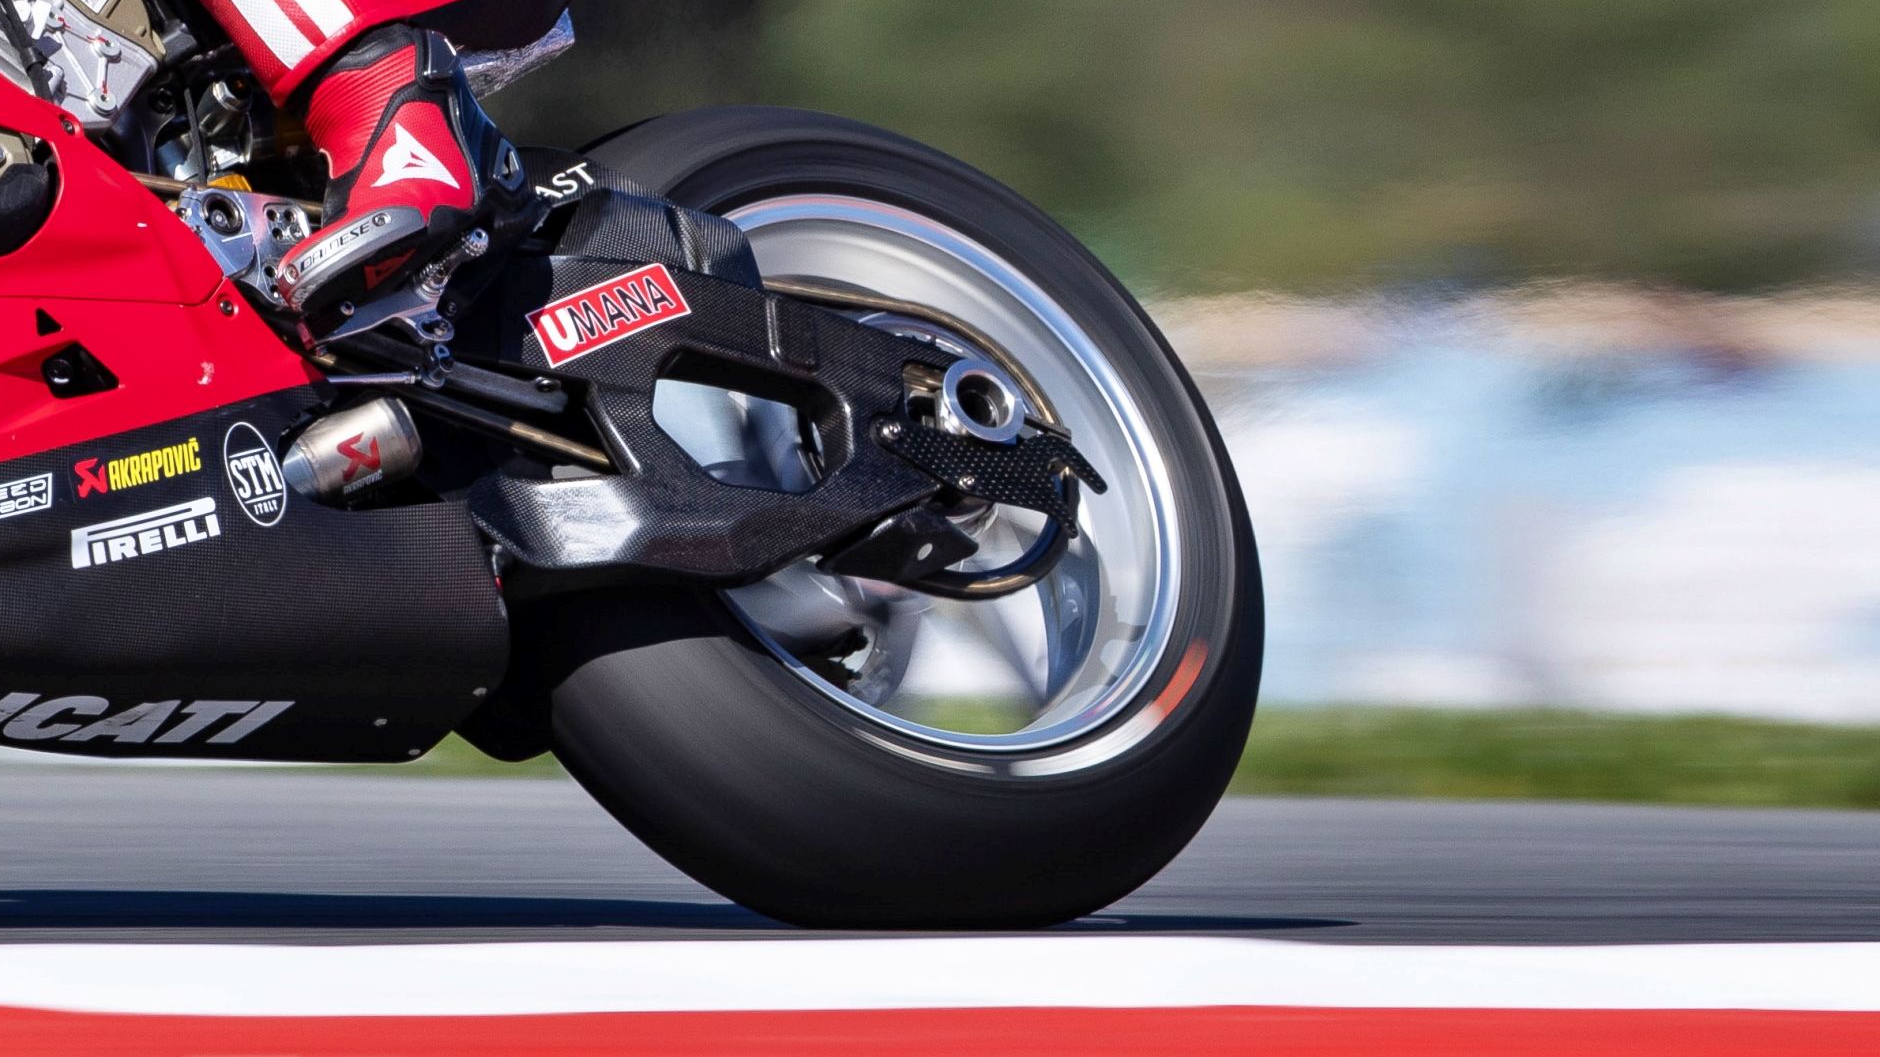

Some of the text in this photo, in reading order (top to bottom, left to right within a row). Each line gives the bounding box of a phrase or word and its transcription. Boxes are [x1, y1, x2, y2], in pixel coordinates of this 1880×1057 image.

[540, 275, 675, 352] UMANA
[229, 445, 283, 500] STM
[70, 496, 222, 570] PIRELLI
